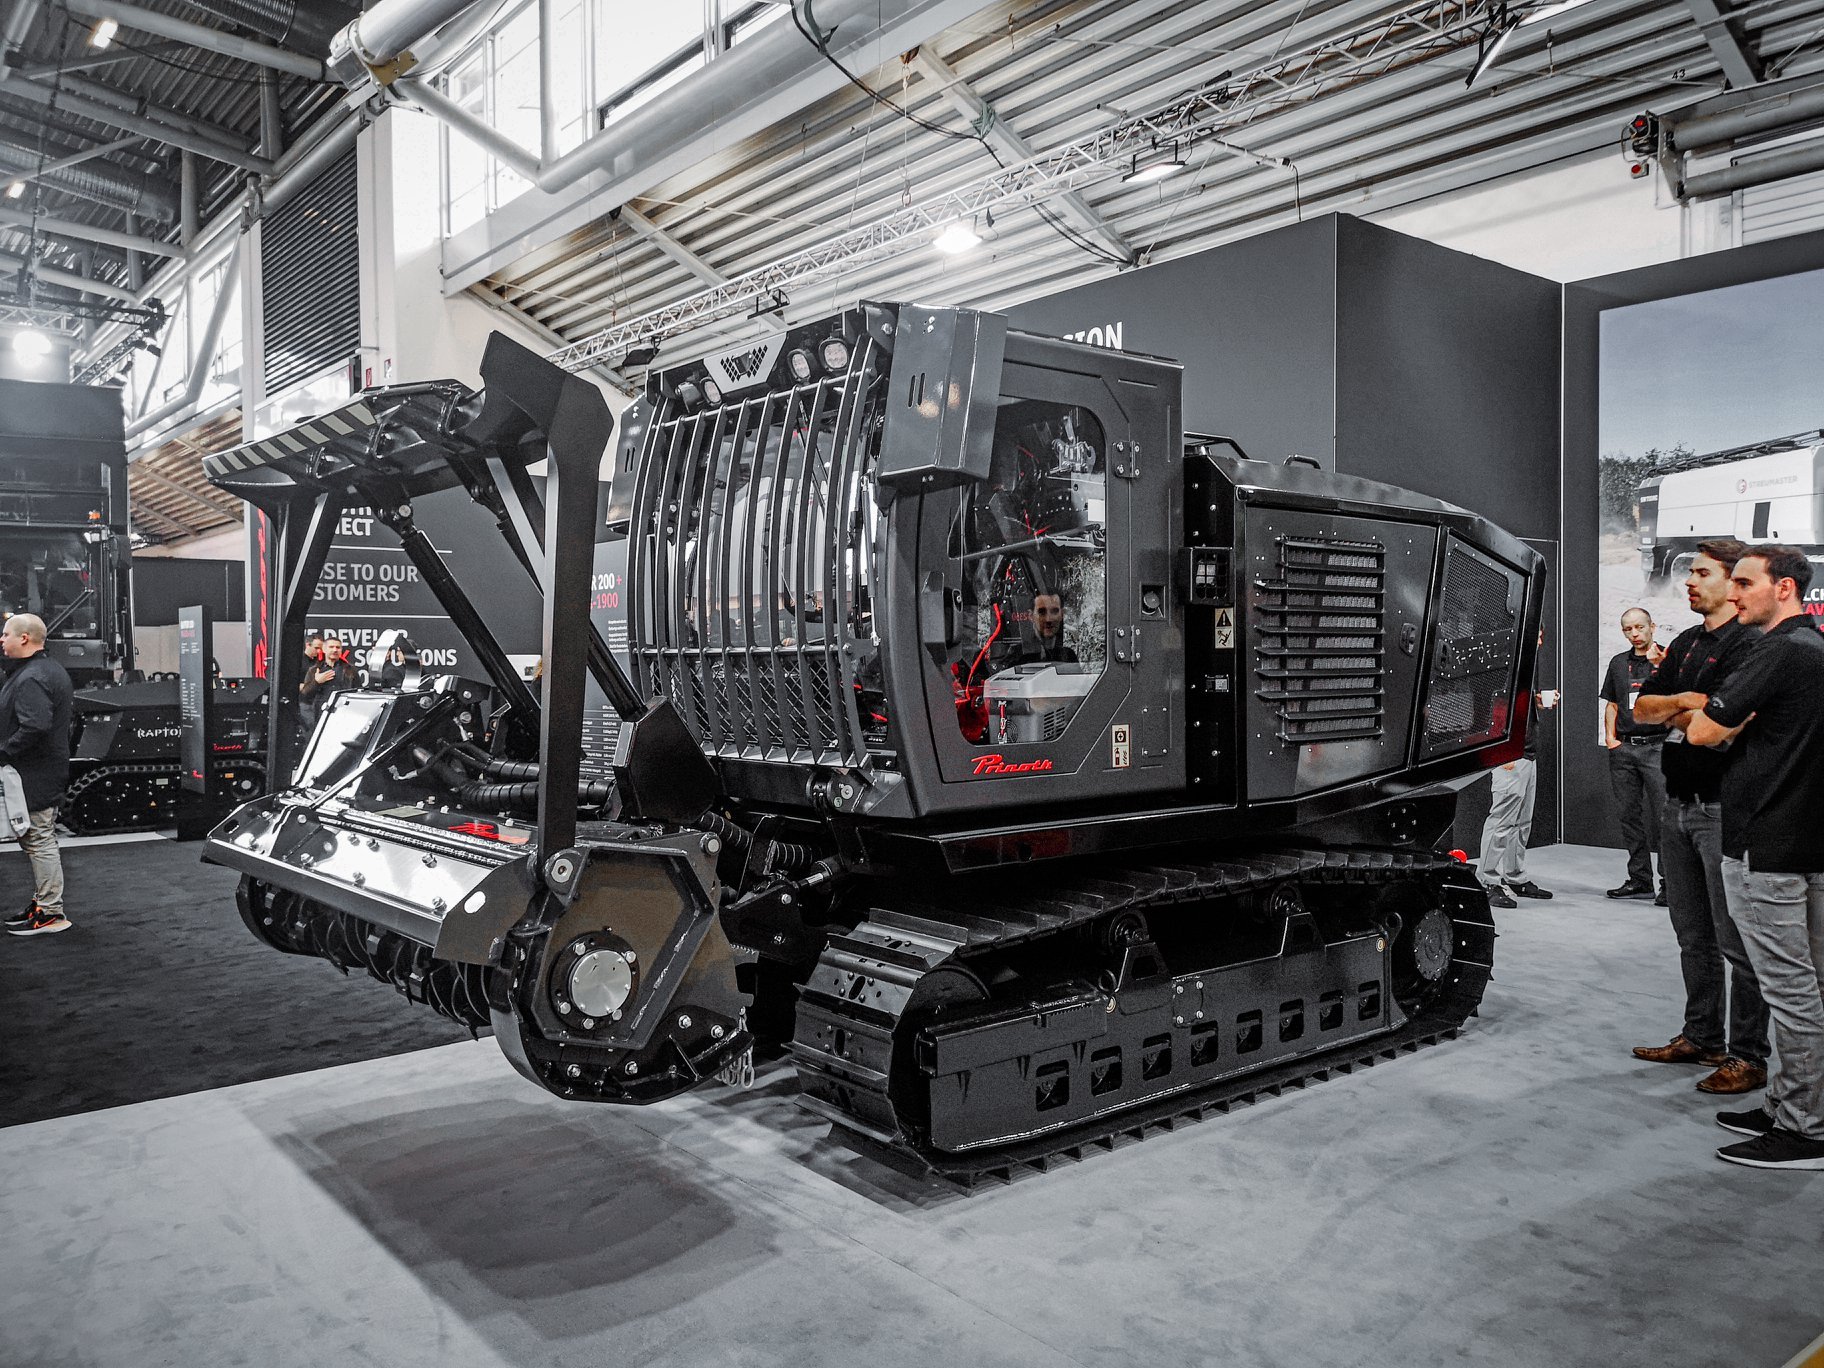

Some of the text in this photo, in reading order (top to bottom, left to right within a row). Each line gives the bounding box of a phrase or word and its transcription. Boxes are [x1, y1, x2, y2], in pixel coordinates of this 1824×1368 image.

[319, 563, 418, 582] SE TO OUR
[598, 573, 615, 590] 200
[590, 592, 619, 609] -1900
[137, 727, 181, 738] RAPTO
[971, 754, 1053, 775] Prinoth
